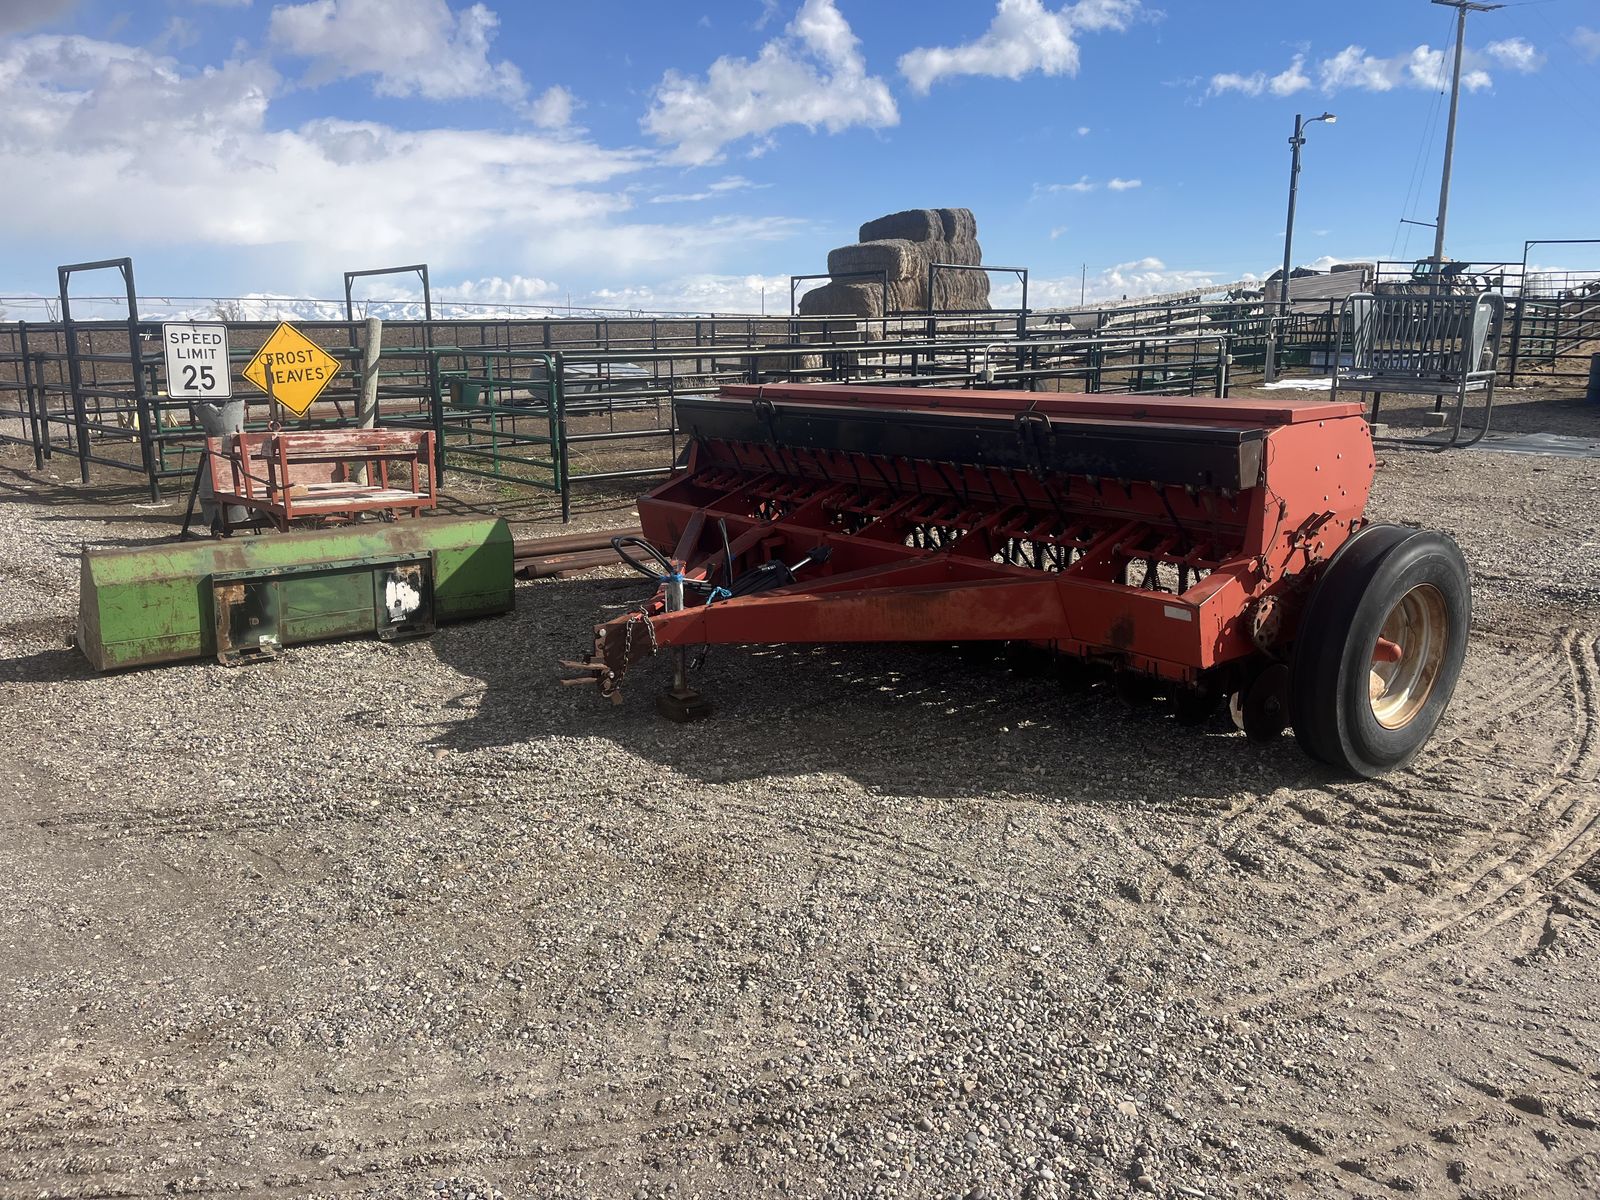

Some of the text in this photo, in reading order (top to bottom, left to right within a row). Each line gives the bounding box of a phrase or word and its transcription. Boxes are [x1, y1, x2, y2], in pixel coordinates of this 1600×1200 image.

[170, 332, 222, 345] SPEED
[177, 348, 217, 359] LIMIT
[182, 364, 216, 391] 25
